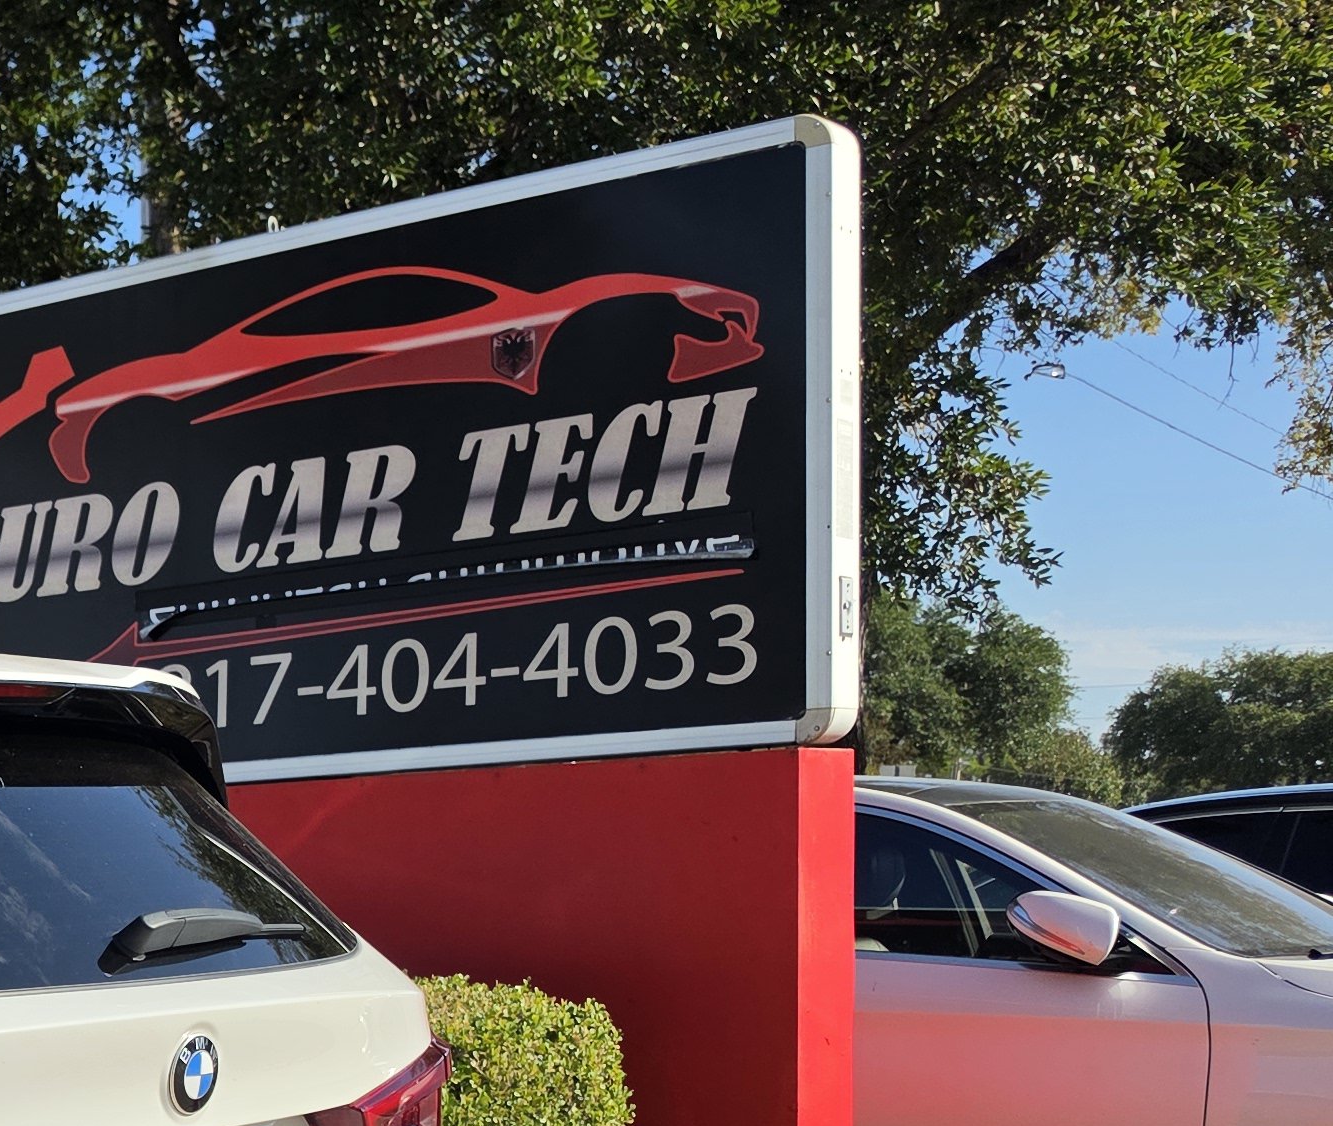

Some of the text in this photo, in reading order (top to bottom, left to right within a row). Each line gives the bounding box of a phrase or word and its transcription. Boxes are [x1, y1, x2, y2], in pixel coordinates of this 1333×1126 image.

[213, 444, 417, 573] CAR
[452, 387, 758, 542] TECH
[159, 603, 758, 729] 17-404-4033
